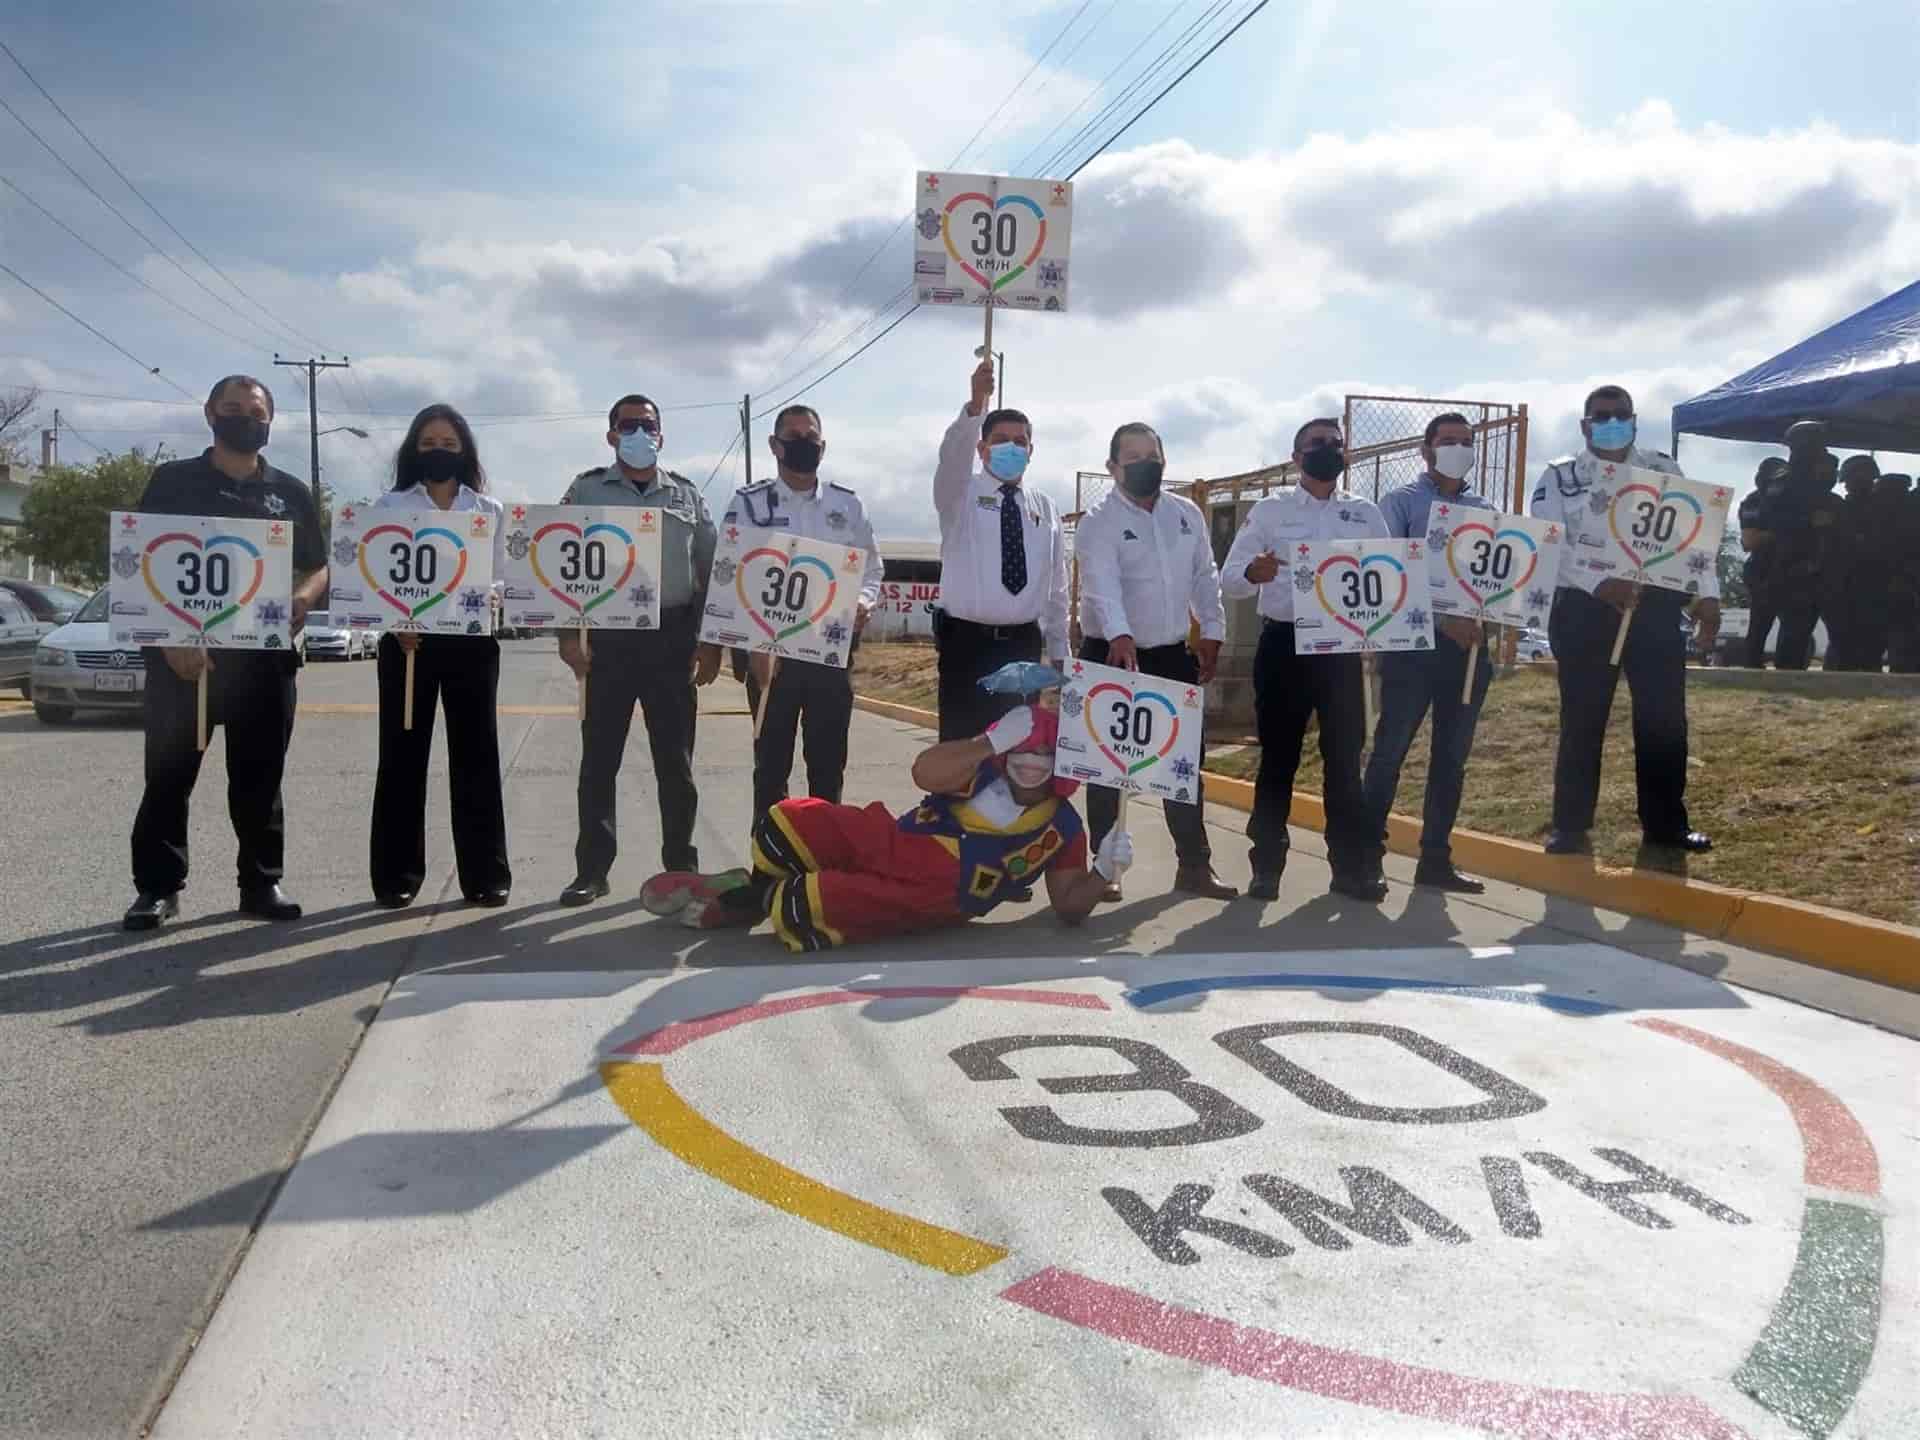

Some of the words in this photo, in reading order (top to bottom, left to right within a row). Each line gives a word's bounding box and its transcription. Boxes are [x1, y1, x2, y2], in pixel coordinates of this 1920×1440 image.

[971, 211, 1017, 257] 30
[976, 258, 1010, 271] KM/H
[1631, 501, 1677, 542] 30
[389, 542, 437, 584] 30
[560, 540, 605, 581] 30
[1470, 540, 1512, 580] 30
[1632, 540, 1664, 553] KM/H
[177, 552, 229, 597] 30
[394, 586, 430, 599] KM/H
[566, 584, 600, 595] KM/H
[761, 566, 809, 611] 30
[1341, 570, 1383, 608] 30
[1472, 578, 1502, 591] KM/H
[183, 600, 223, 611] KM/H
[763, 609, 797, 624] KM/H
[896, 602, 912, 613] 12
[1348, 610, 1379, 620] KM/H
[1110, 702, 1152, 746] 30
[1113, 743, 1145, 758] KM/H
[948, 1020, 1547, 1147] 30
[1100, 1147, 1752, 1266] KM/H
